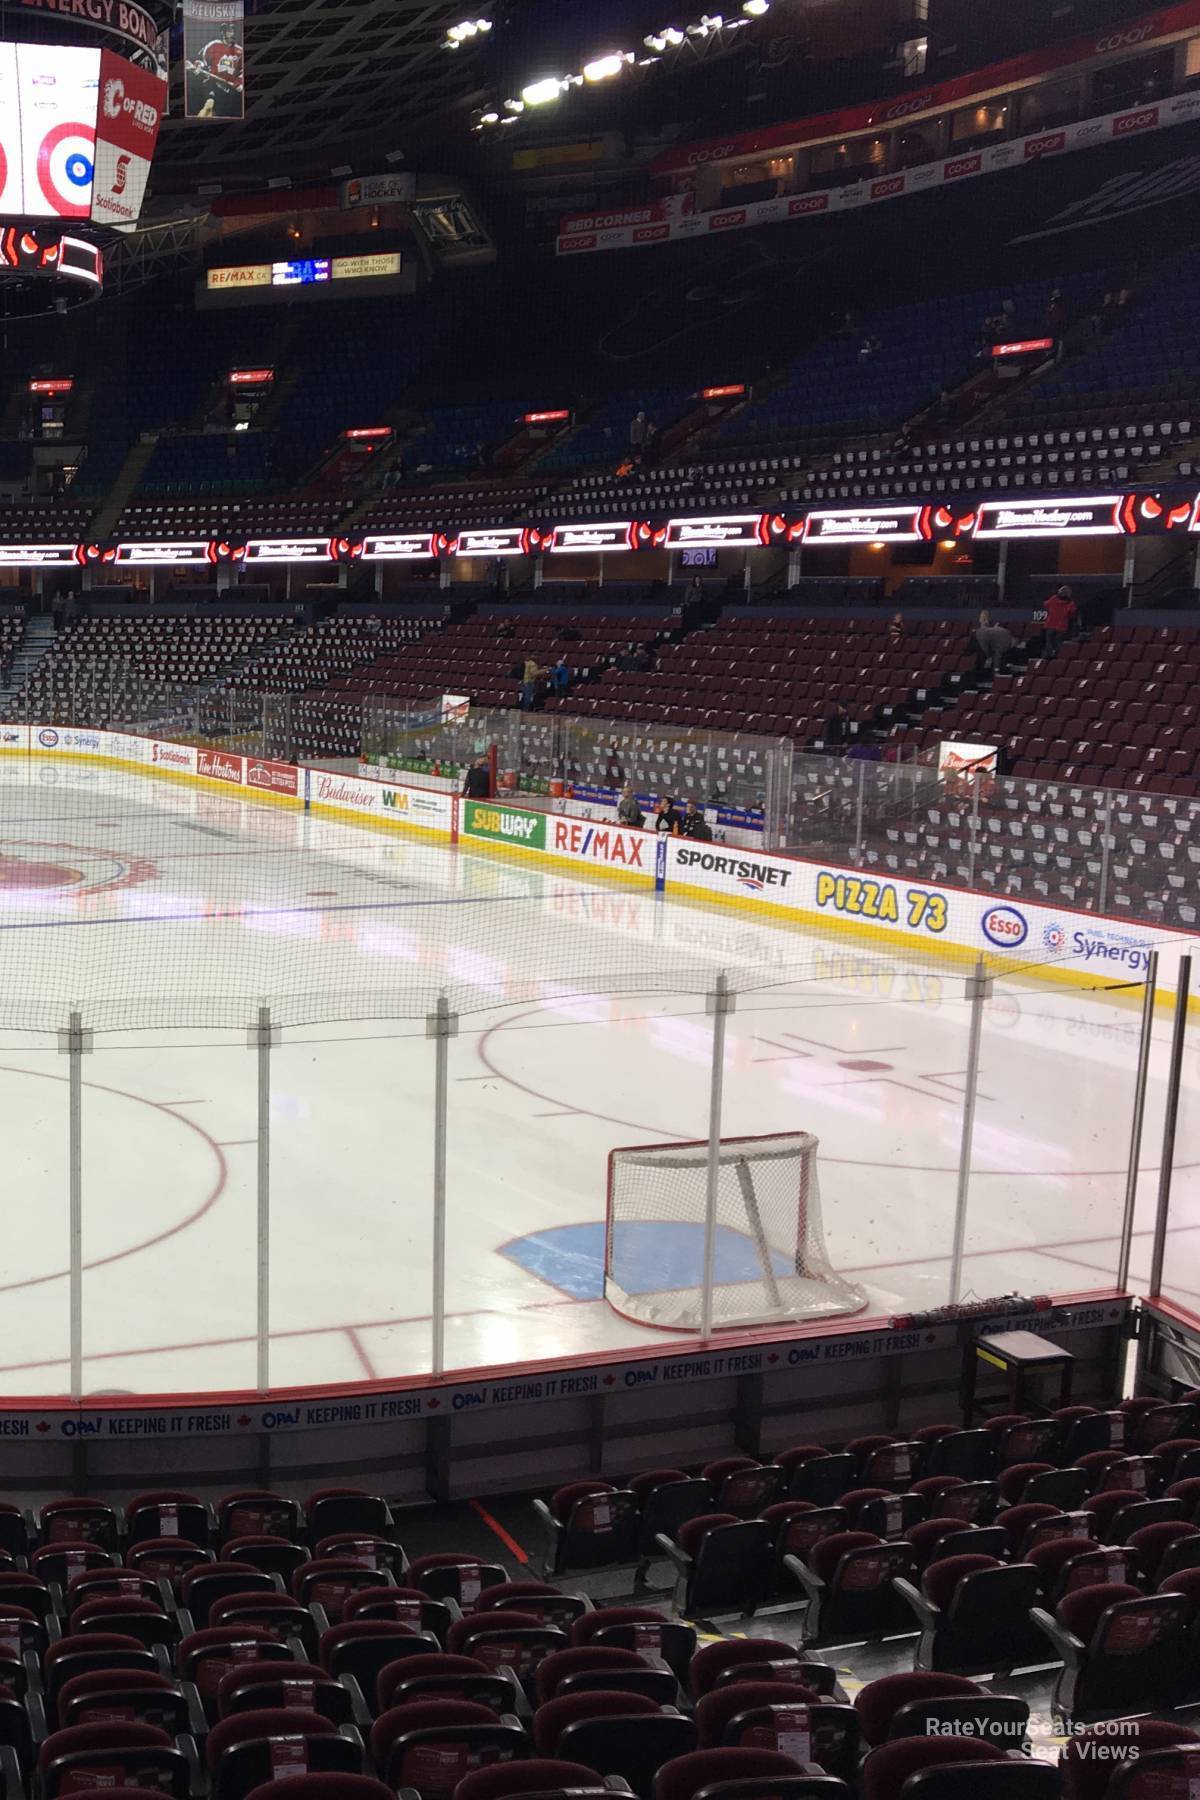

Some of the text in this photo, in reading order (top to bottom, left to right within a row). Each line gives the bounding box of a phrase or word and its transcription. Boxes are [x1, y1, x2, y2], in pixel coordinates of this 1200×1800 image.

[123, 97, 135, 113] OF
[134, 100, 158, 127] RED
[96, 193, 134, 219] Scotiabank
[364, 188, 402, 199] HOCKEY
[212, 271, 254, 283] RE/MAX
[74, 736, 99, 749] Synergy
[159, 747, 190, 765] Scotiabank
[198, 753, 212, 774] Tim
[211, 755, 241, 783] Hortons
[317, 776, 376, 807] Budweiser
[472, 808, 538, 839] SUBWAY
[555, 821, 644, 867] RE/MAX
[676, 847, 792, 888] SPORTSNET
[816, 871, 948, 932] PIZZA 73
[1073, 931, 1151, 971] Synergy
[1072, 1309, 1105, 1327] FRESH
[788, 1333, 920, 1365] OPA! KEEPING IT FRESH
[625, 1353, 762, 1387] OPA! KEEPING IT FRESH
[452, 1375, 598, 1410] OPA! KEEPING IT FRESH
[62, 1414, 231, 1436] OPA! KEEPING IT FRESH
[262, 1398, 421, 1429] OPA! KEEPING IT FRESH
